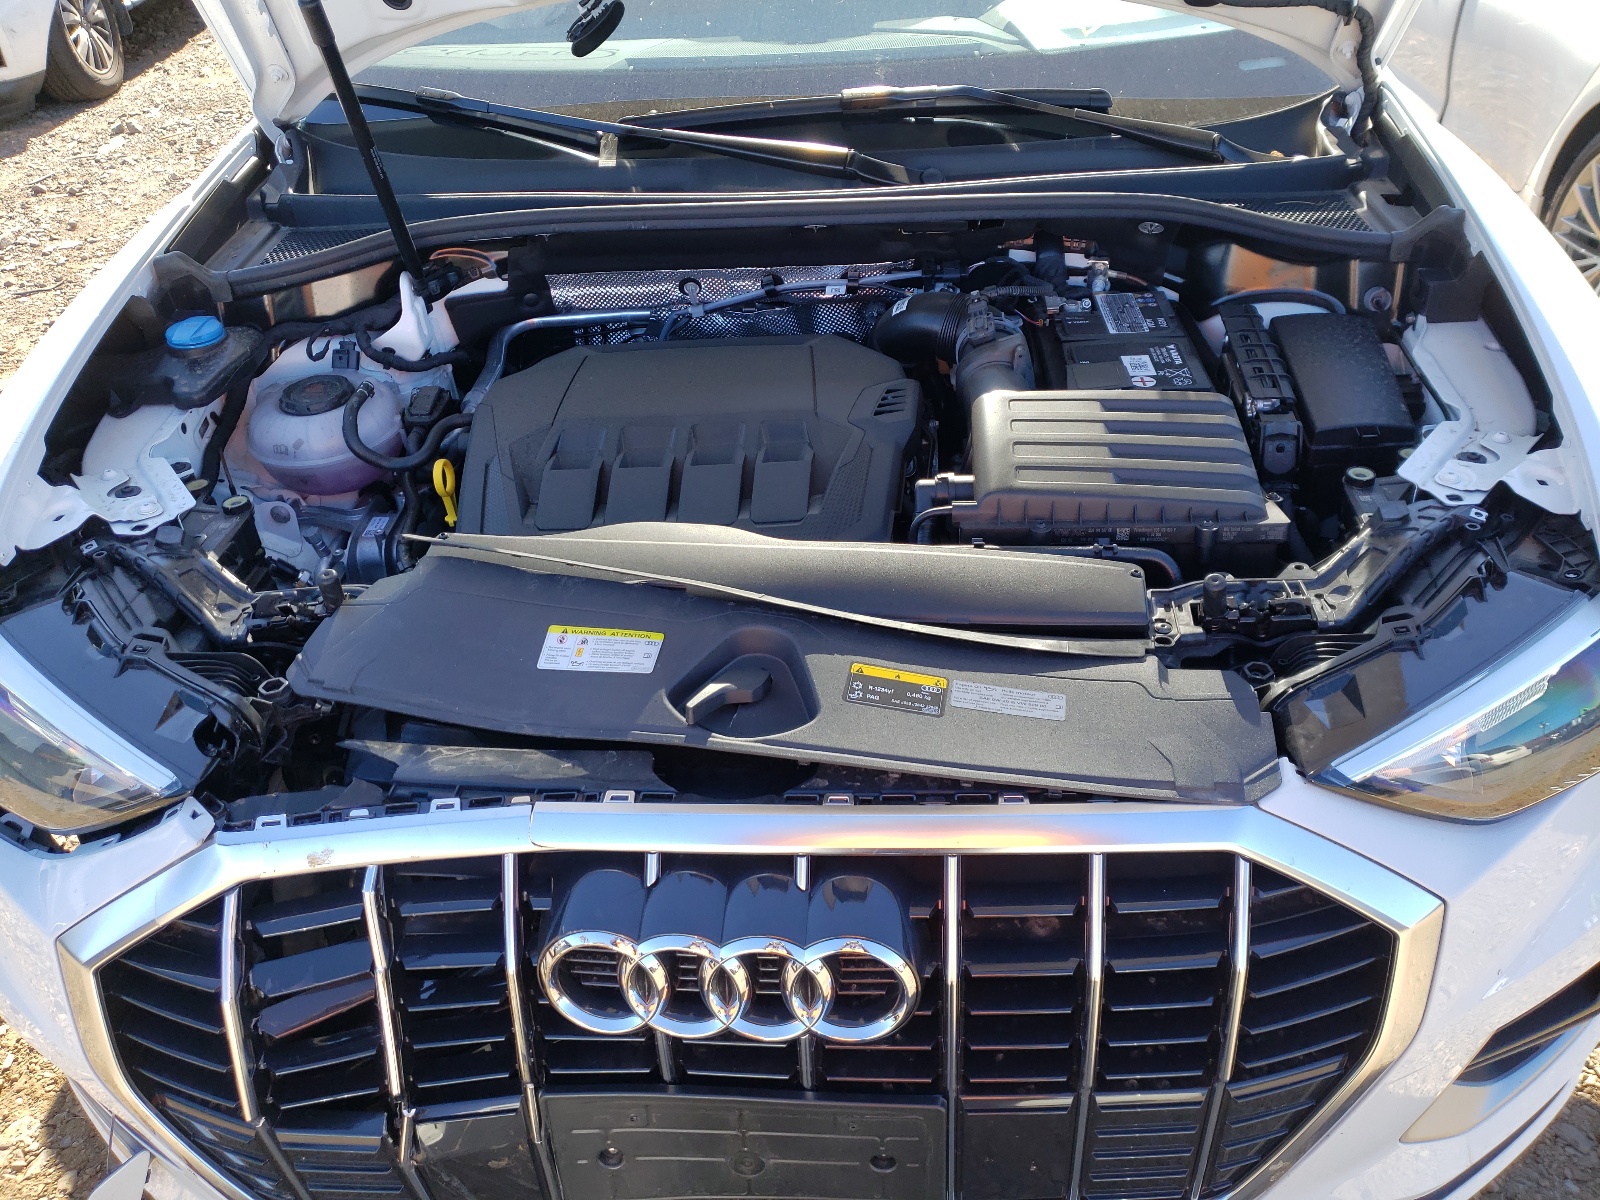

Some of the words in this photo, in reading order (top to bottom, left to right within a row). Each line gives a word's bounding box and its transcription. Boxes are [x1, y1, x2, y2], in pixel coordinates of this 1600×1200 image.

[610, 631, 652, 639] ATTENTION
[868, 685, 895, 695] R-1234yf
[866, 693, 880, 701] PAG
